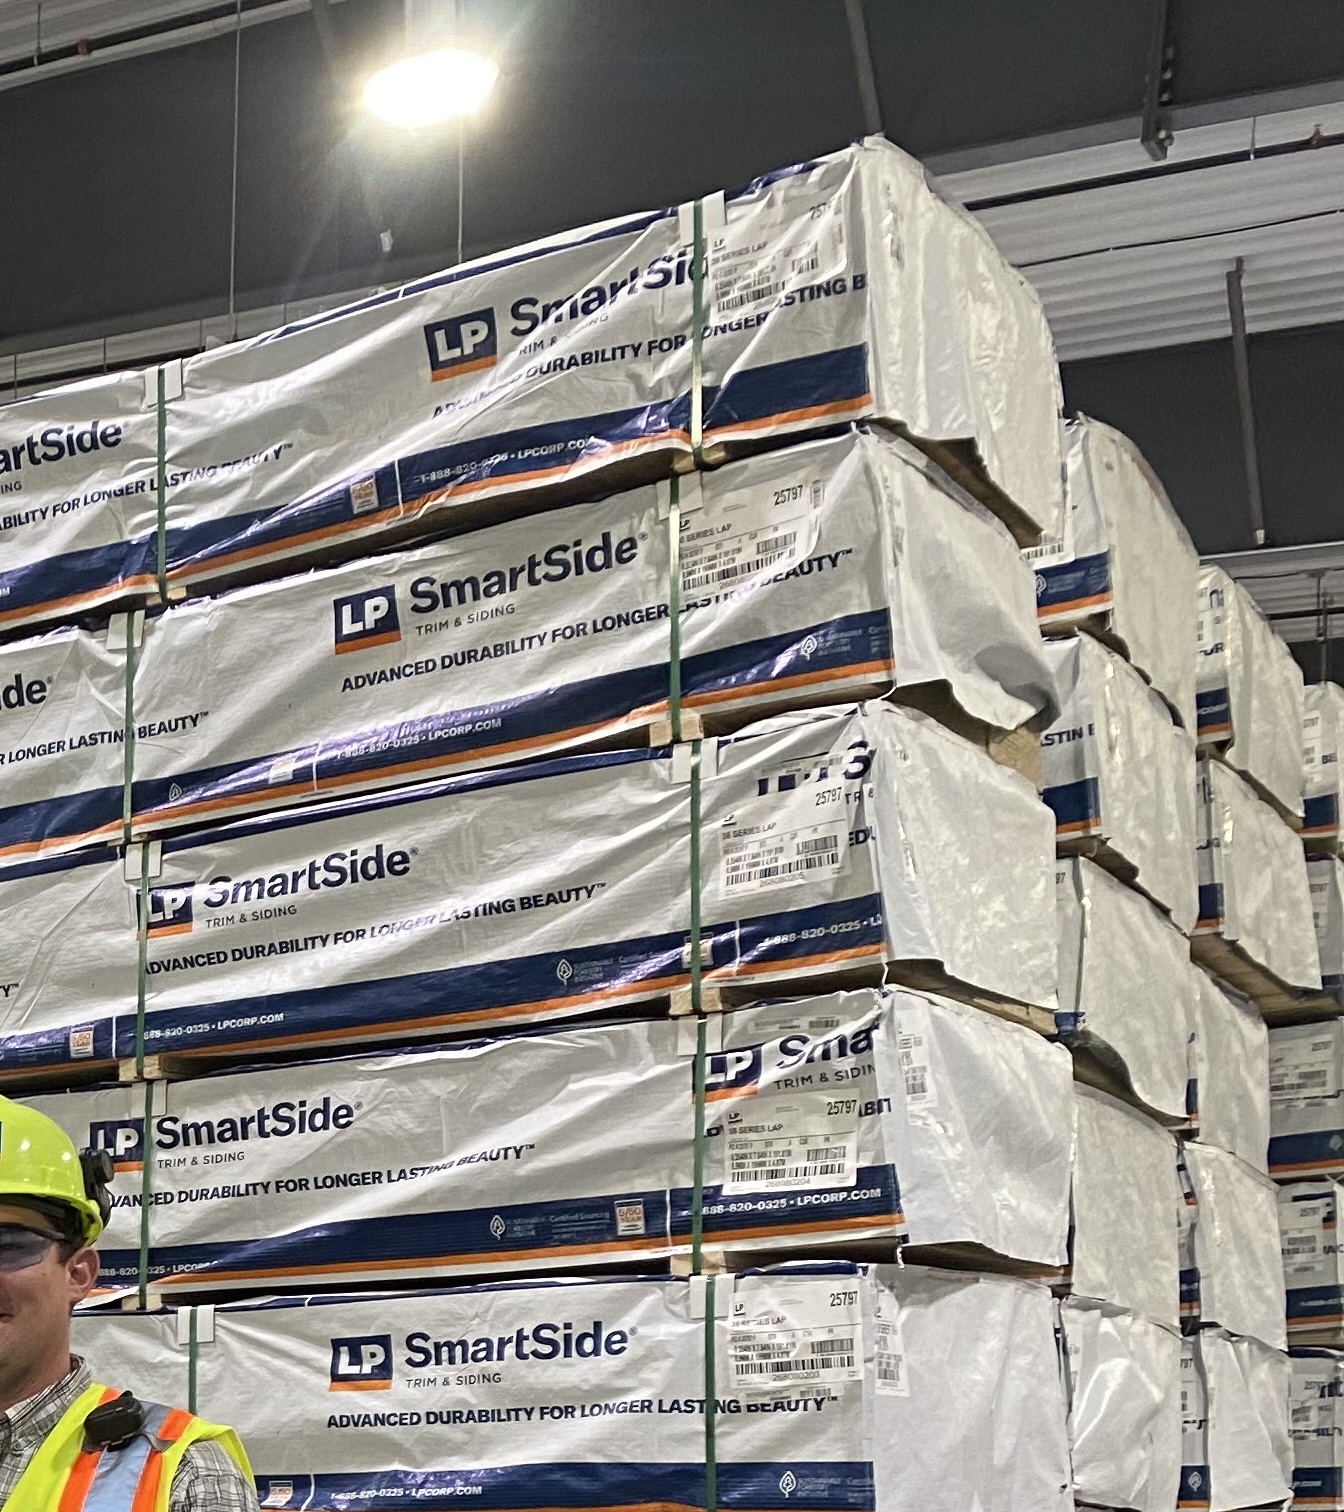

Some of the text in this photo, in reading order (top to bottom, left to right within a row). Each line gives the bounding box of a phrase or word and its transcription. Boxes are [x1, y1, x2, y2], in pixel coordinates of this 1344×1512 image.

[434, 320, 489, 362] LP
[525, 335, 686, 378] DURABILITY FOR
[52, 499, 80, 518] FOR
[83, 480, 145, 506] LONGER
[774, 484, 803, 506] 25797
[341, 596, 389, 635] LP
[415, 604, 516, 636] TRIM SIDING
[341, 603, 670, 693] ADVANCED DURABILITY FOR LONGER
[429, 718, 502, 740] LPCORP.COM
[9, 740, 65, 763] LONGER
[70, 728, 135, 750] LASTIN
[815, 787, 842, 806] 25797
[148, 890, 186, 922] LP
[206, 905, 298, 929] TRIM SIDING
[231, 934, 330, 962] DURABILITY
[333, 928, 366, 945] FOR
[370, 914, 437, 938] LONGER
[439, 900, 516, 923] LASTING
[218, 1012, 284, 1030] LPCORP.COM
[706, 1051, 753, 1083] LP
[775, 1073, 830, 1090] TRIM &
[827, 1099, 857, 1116] 25797
[98, 1128, 139, 1157] LP
[738, 1123, 784, 1134] SERIES LAP
[158, 1151, 245, 1168] TRIM SIDING
[178, 1159, 454, 1203] DURABILITY FOR LONGER LASTING
[797, 1188, 882, 1206] LPCORP.COM
[830, 1291, 858, 1307] 25797
[338, 1344, 386, 1374] LP
[406, 1373, 502, 1388] TRIM SIDING
[327, 1399, 741, 1428] ADVANCED DURABILITY FOR LONGER LASTNG
[411, 1485, 482, 1497] LPCORP.COM
